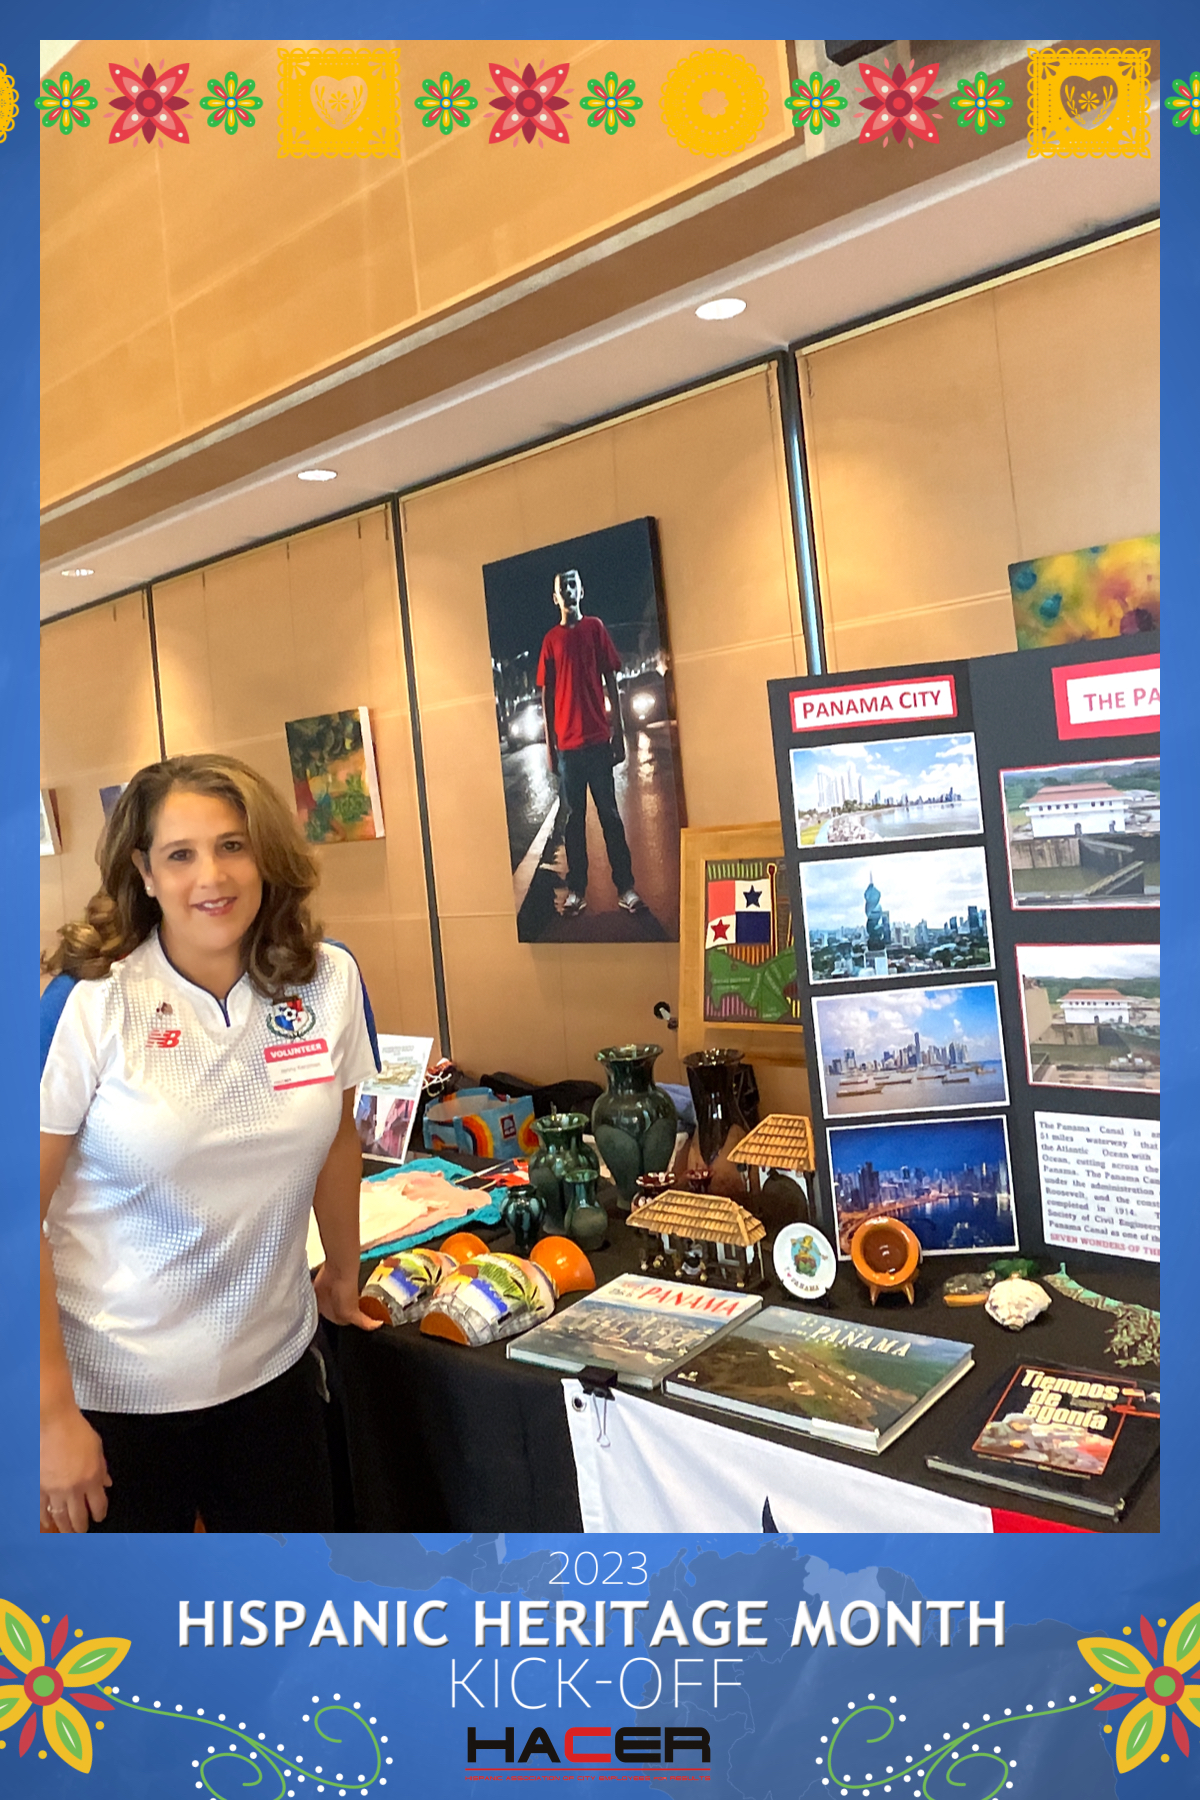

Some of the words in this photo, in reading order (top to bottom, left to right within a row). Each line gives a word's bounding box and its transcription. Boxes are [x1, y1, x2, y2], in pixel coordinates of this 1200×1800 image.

[803, 695, 893, 719] PANAMA
[900, 690, 941, 709] CITY
[1083, 691, 1126, 711] THE
[1133, 687, 1160, 706] PA
[270, 1043, 322, 1059] VOLUNTEER
[1039, 1121, 1054, 1129] The
[1057, 1123, 1090, 1132] Panama
[1099, 1126, 1124, 1135] Canal
[1052, 1134, 1074, 1142] miles
[1086, 1138, 1128, 1148] waterway
[1140, 1141, 1158, 1149] that
[1057, 1145, 1088, 1154] Atlantic
[1102, 1149, 1129, 1158] Ocean
[1132, 1153, 1151, 1161] with
[1076, 1159, 1105, 1169] cutting
[1112, 1162, 1139, 1171] across
[1145, 1165, 1158, 1173] the
[1085, 1170, 1101, 1178] The
[1105, 1173, 1139, 1183] Panama
[1045, 1177, 1068, 1185] under
[1072, 1178, 1086, 1188] the
[1091, 1182, 1154, 1195] administration
[1047, 1199, 1089, 1211] completed
[1116, 1196, 1130, 1204] the
[1048, 1209, 1077, 1221] Society
[1082, 1214, 1090, 1222] of
[1095, 1216, 1114, 1225] Civil
[1049, 1220, 1081, 1231] Panama
[1084, 1225, 1108, 1235] Canal
[1111, 1229, 1120, 1237] as
[1122, 1231, 1138, 1239] one
[1140, 1233, 1149, 1241] of
[1050, 1233, 1078, 1243] SEVEN
[1080, 1237, 1125, 1250] WONDERS
[1128, 1244, 1140, 1252] OF
[637, 1286, 740, 1316] PANAMA
[809, 1325, 912, 1357] PANAMA
[1021, 1369, 1120, 1401] Tiempos
[1029, 1389, 1062, 1407] de
[1023, 1403, 1108, 1430] agonía
